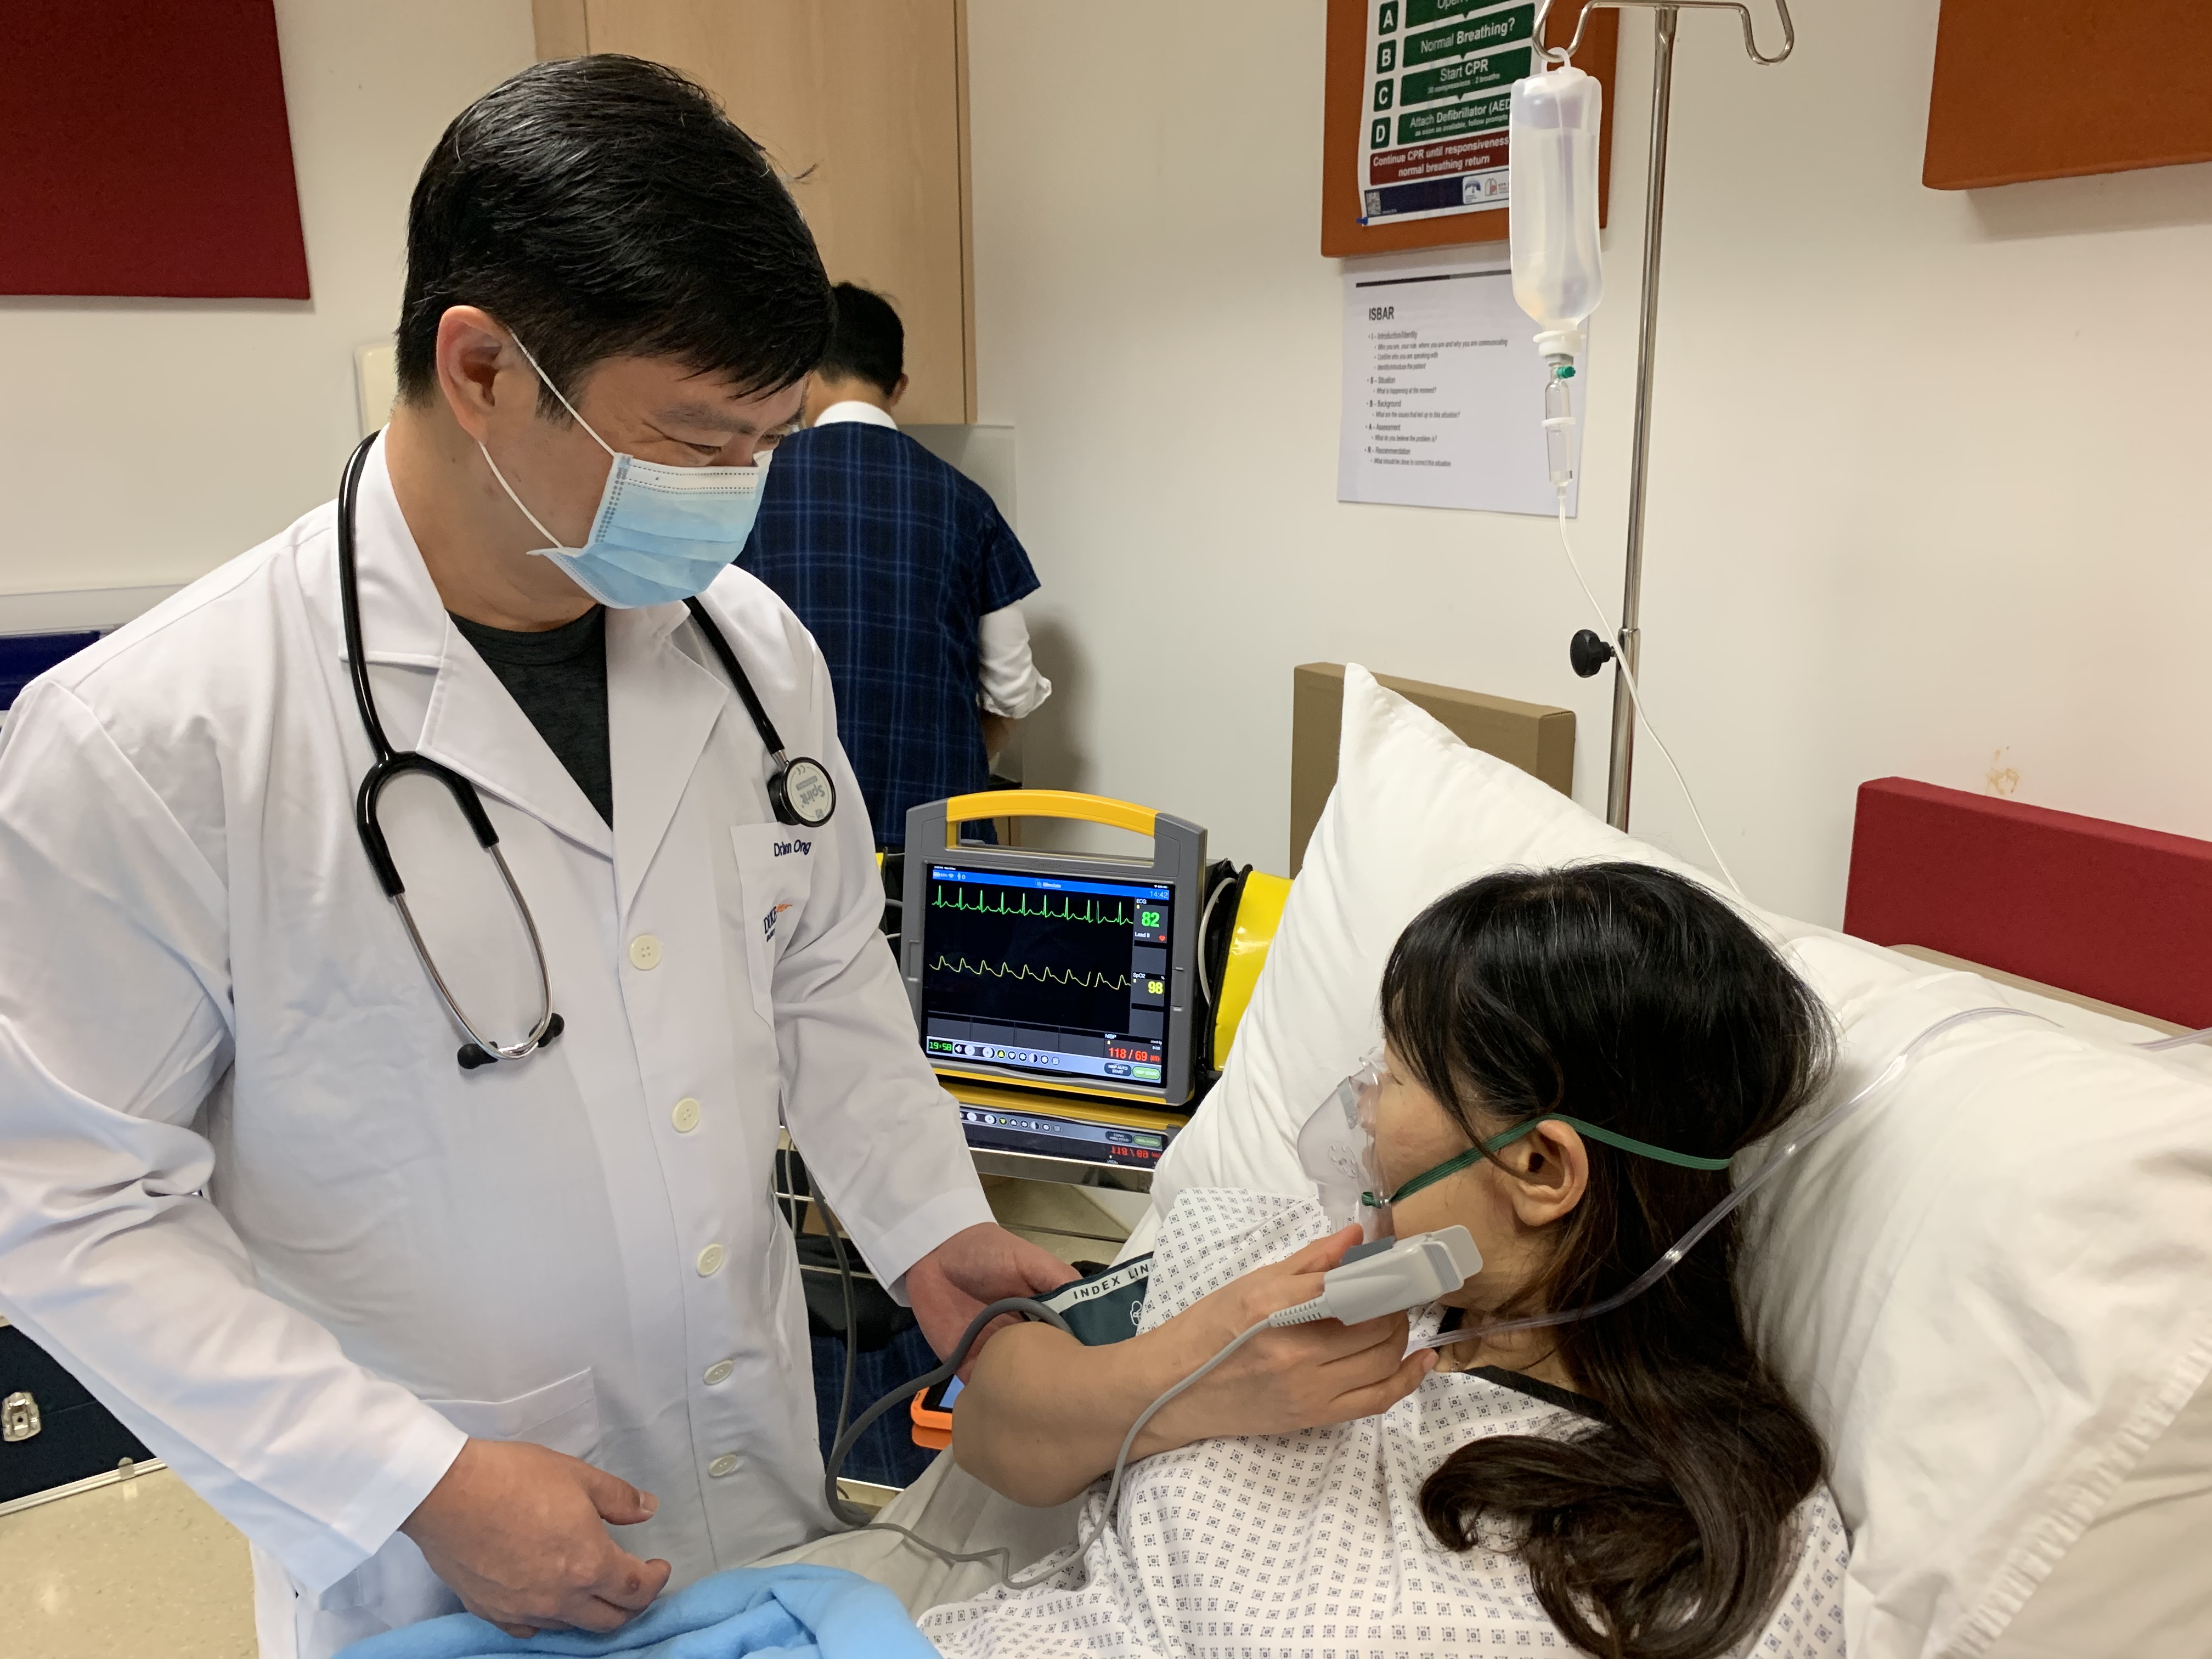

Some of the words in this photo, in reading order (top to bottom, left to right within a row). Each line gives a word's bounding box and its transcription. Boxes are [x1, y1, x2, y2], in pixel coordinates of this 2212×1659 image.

[1383, 9, 1393, 27] A
[1421, 33, 1453, 53] Normal
[1457, 17, 1515, 44] Breathing?
[1381, 48, 1392, 66] B
[1440, 67, 1462, 82] Start
[1465, 59, 1488, 76] CPR
[1379, 87, 1389, 104] C
[1410, 116, 1435, 128] Attach
[1436, 104, 1487, 123] Defibrillator
[1376, 125, 1386, 143] D
[1373, 153, 1406, 167] Continue
[1407, 149, 1425, 161] CPR
[1426, 146, 1443, 158] until
[1445, 137, 1510, 155] responsiveness
[1398, 164, 1425, 177] normal
[1426, 158, 1463, 172] breathing
[1465, 155, 1489, 166] return
[1369, 307, 1394, 320] ISBAR
[1377, 400, 1401, 409] Background
[1375, 447, 1410, 455] Recommendation
[793, 839, 811, 855] Ong
[1150, 890, 1168, 899] 14:42
[1142, 911, 1160, 927] 82
[1148, 981, 1163, 994] 98
[929, 1041, 952, 1051] 19:58
[1109, 1047, 1126, 1059] 118
[1135, 1050, 1148, 1062] 69
[1074, 1276, 1121, 1299] INDEX
